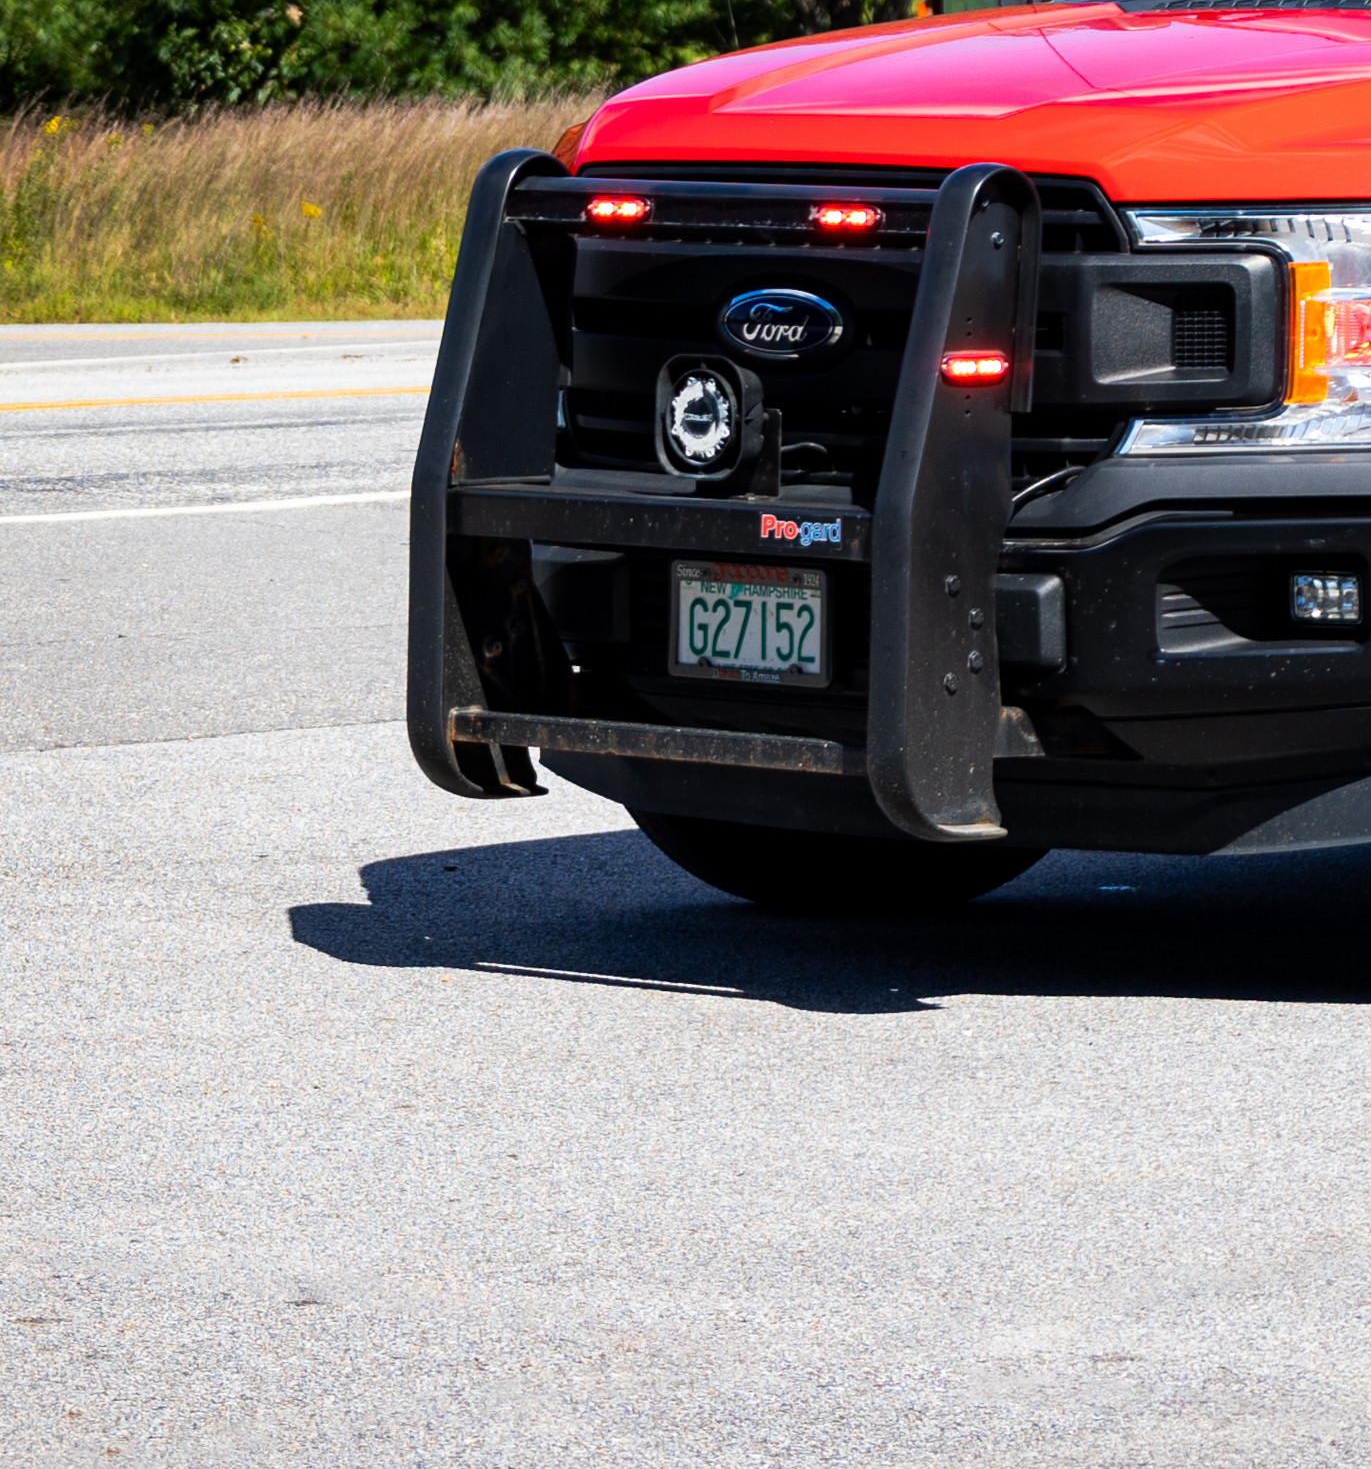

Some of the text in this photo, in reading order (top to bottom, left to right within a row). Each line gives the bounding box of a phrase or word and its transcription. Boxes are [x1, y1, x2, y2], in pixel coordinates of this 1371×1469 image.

[743, 303, 809, 343] Ford
[676, 564, 701, 579] Since
[700, 580, 809, 601] NEW HAMPSHIRE
[689, 597, 816, 664] G27152
